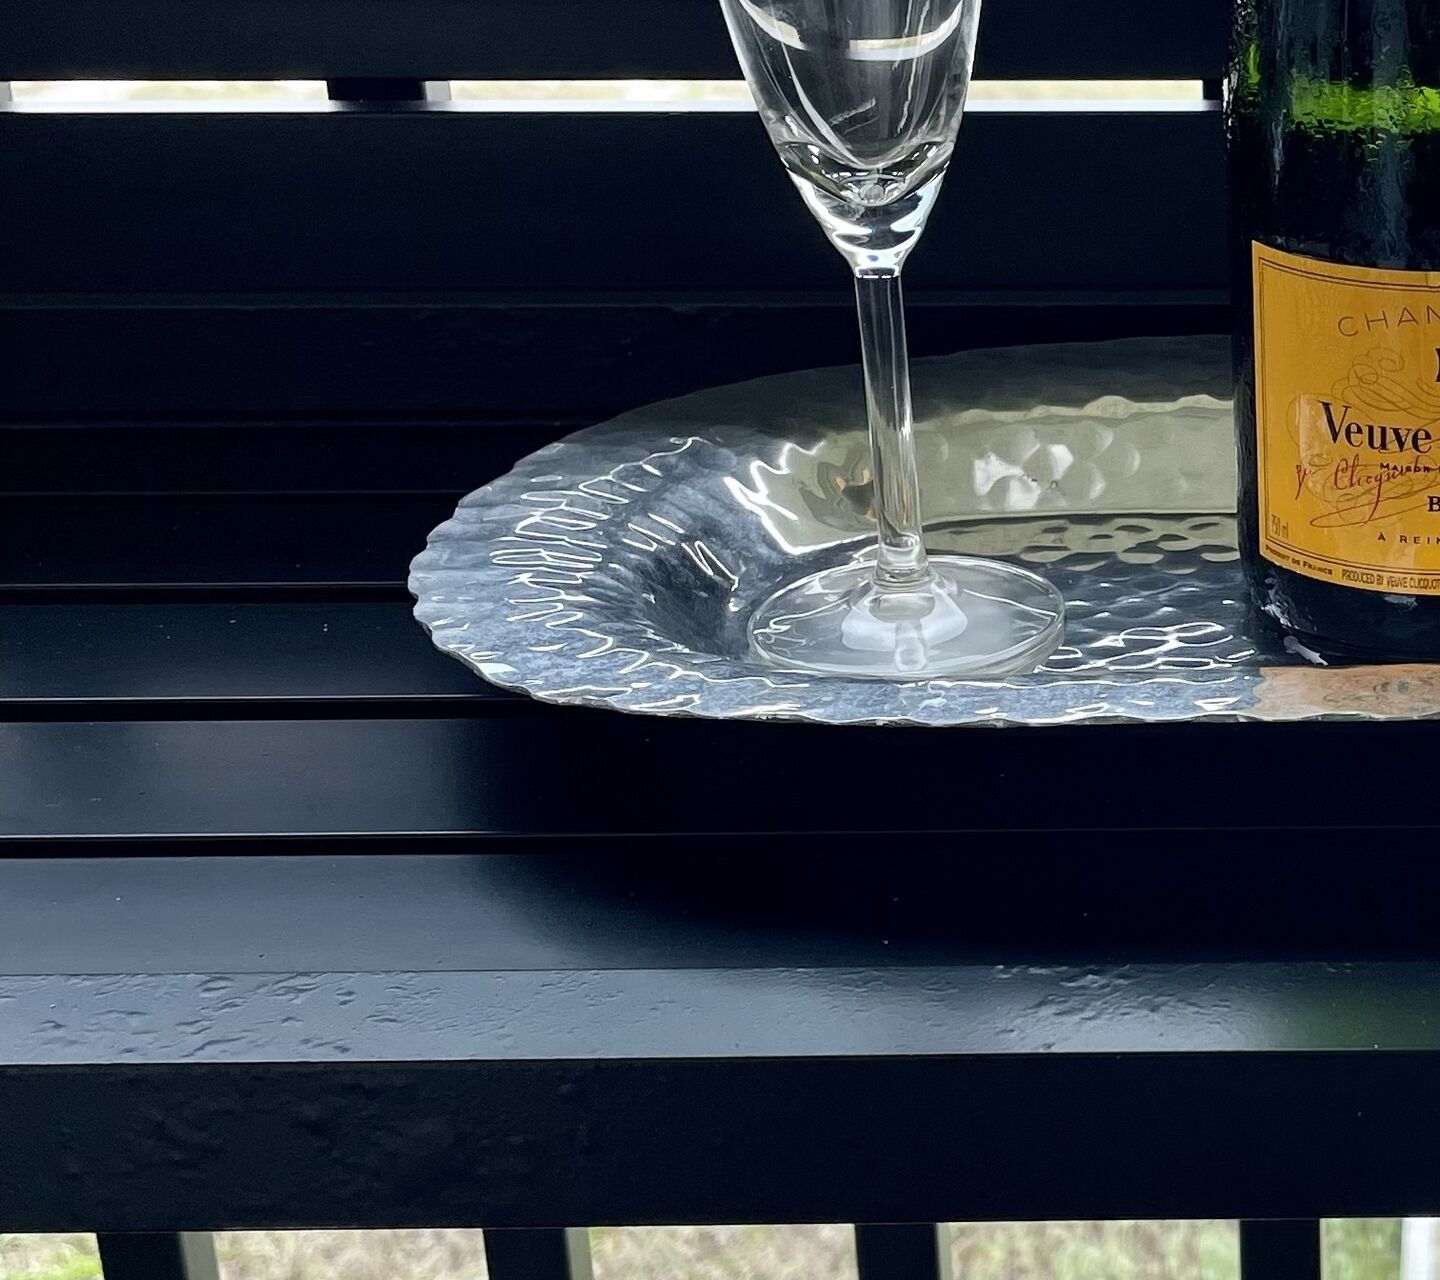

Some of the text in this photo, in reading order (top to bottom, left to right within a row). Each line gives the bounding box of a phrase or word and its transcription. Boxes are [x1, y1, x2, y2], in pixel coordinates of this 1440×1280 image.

[1318, 400, 1432, 453] Veuve
[1303, 561, 1333, 576] FRANCE
[1341, 568, 1375, 585] PRODUCED
[1386, 575, 1408, 589] VEUVE
